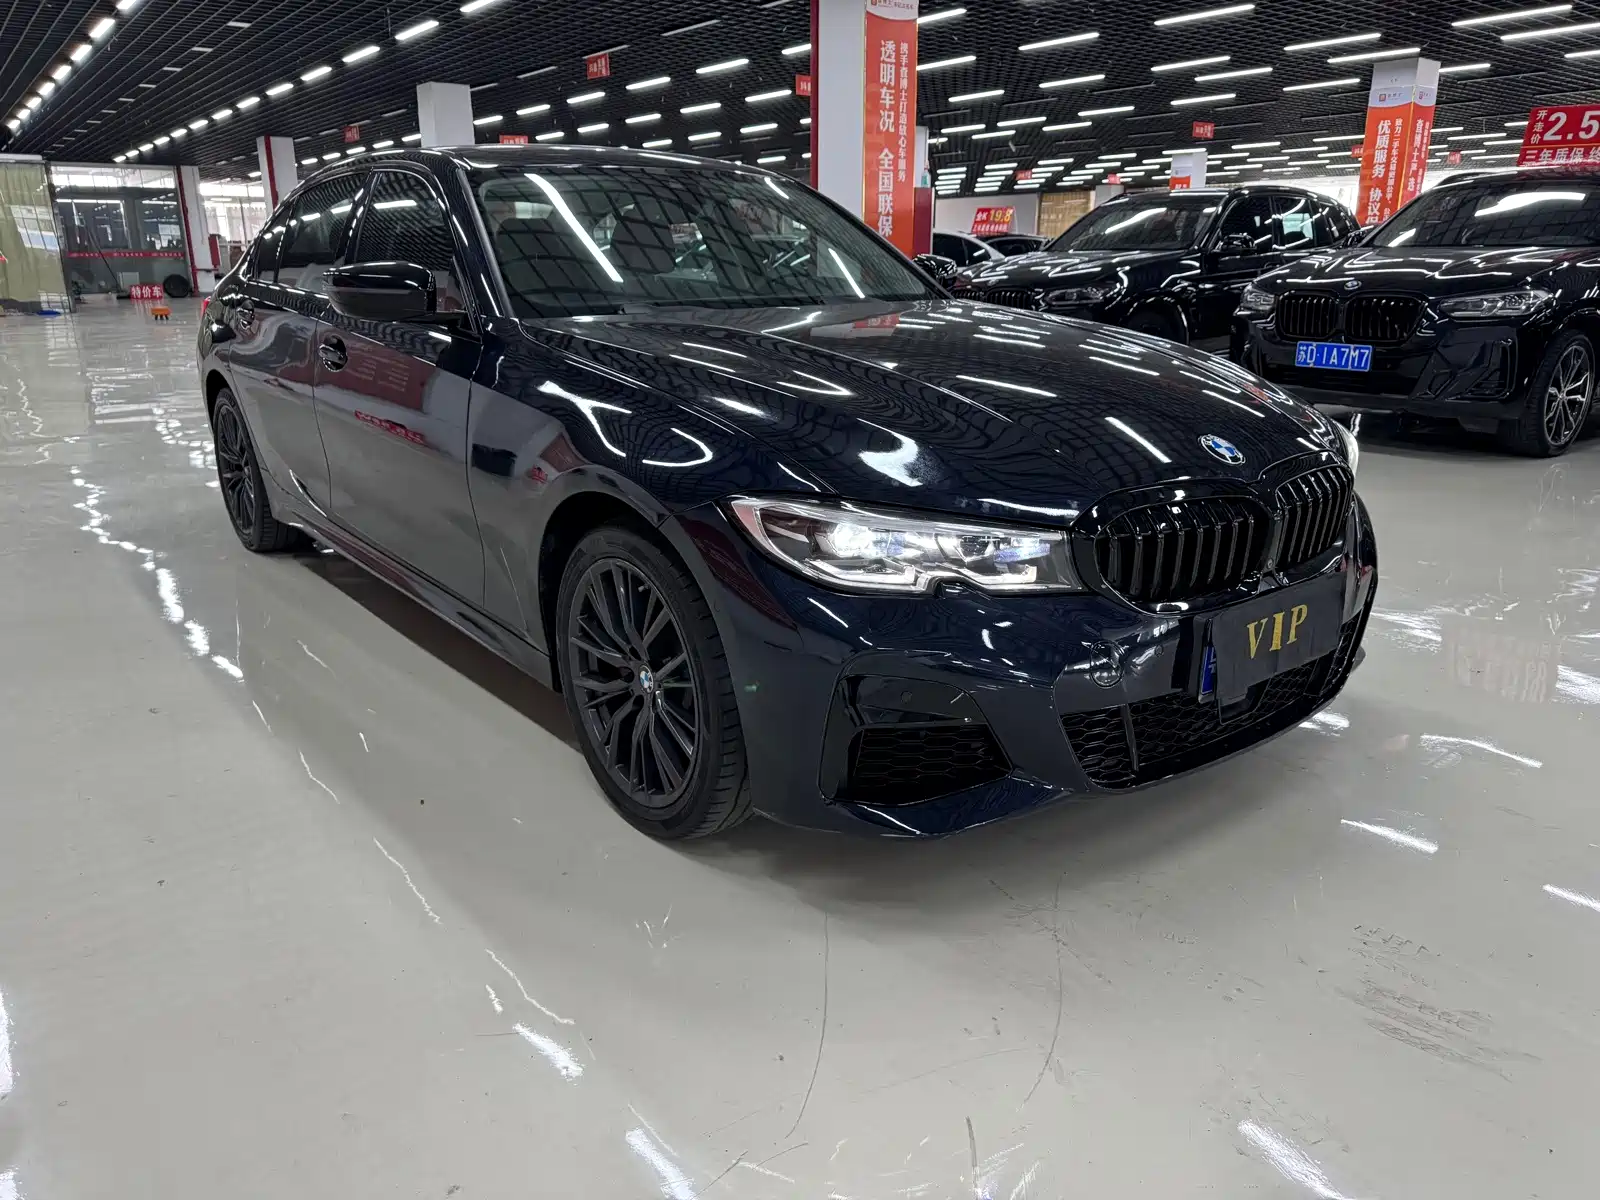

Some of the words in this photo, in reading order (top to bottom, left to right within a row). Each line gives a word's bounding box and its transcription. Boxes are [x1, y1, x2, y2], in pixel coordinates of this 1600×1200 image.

[880, 39, 896, 133] 透明车况
[1372, 119, 1392, 179] 优质服务
[1530, 109, 1549, 145] 开走价
[1522, 147, 1585, 165] 三年质保
[878, 147, 894, 238] 全国联保
[990, 208, 1014, 222] 19.8
[131, 285, 162, 299] 特价车
[1246, 604, 1308, 660] VIP
